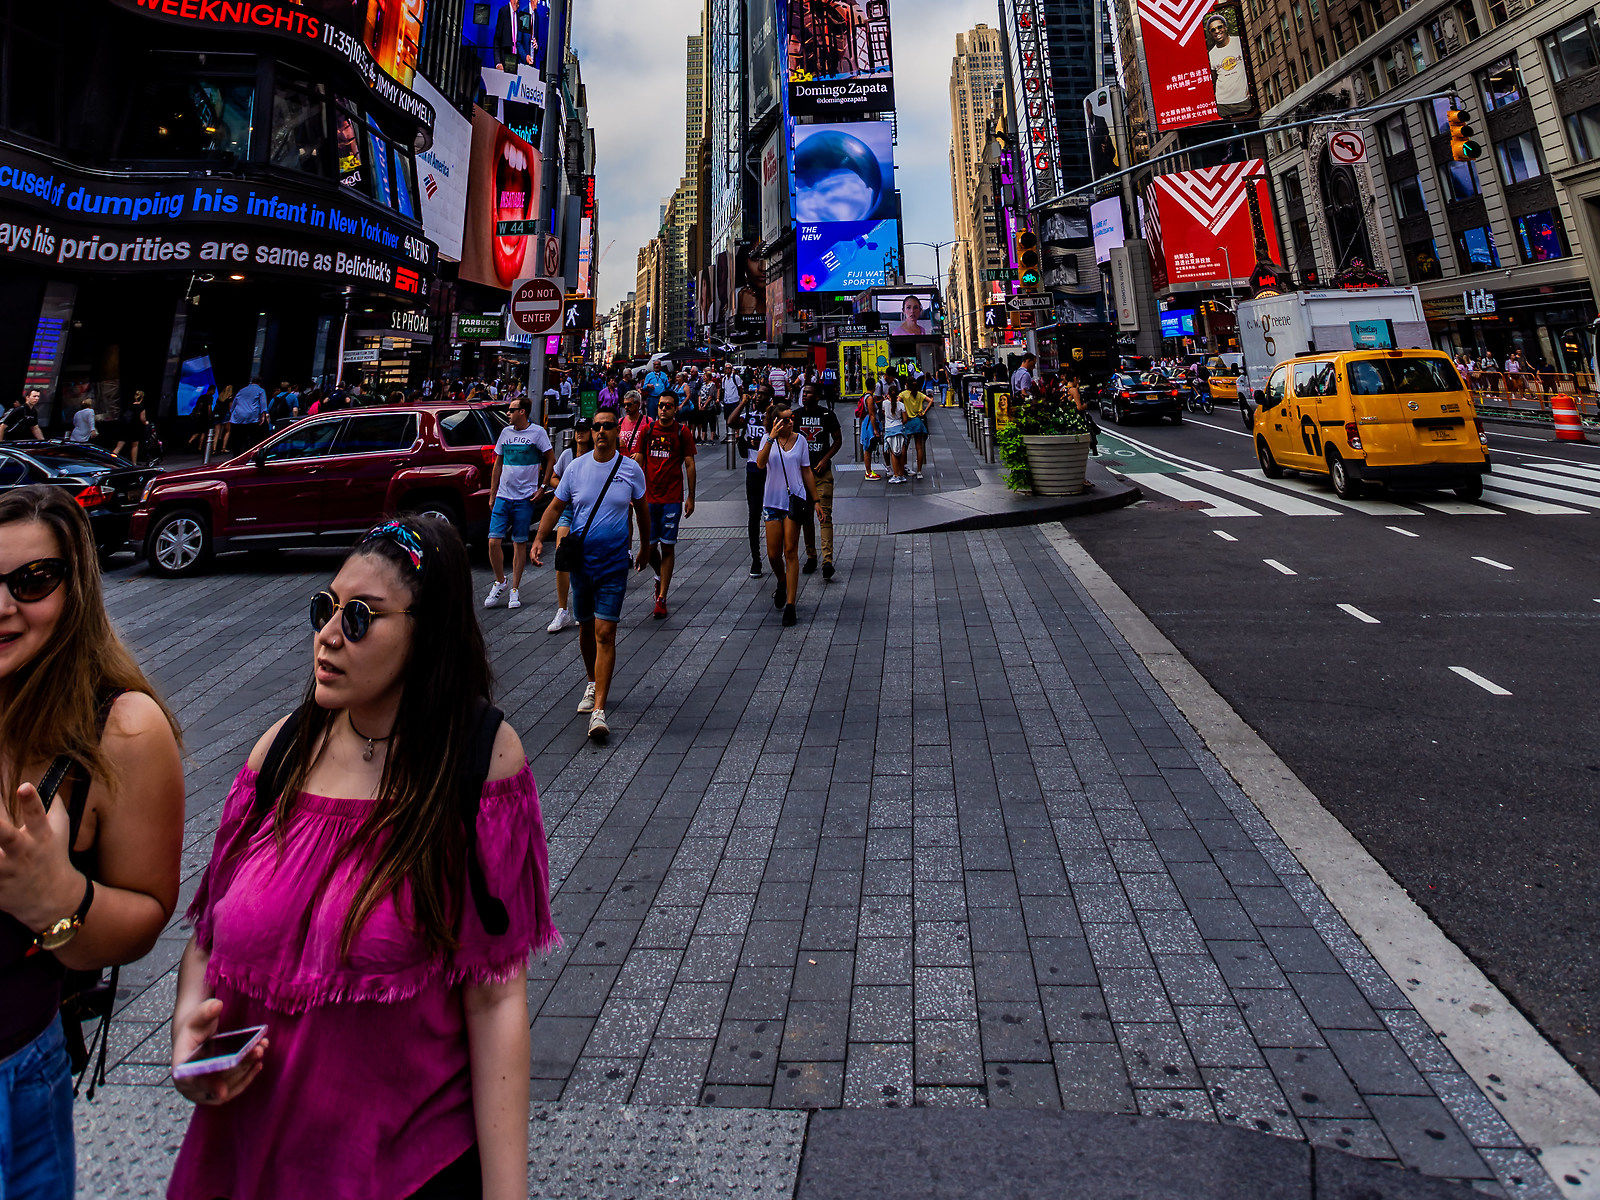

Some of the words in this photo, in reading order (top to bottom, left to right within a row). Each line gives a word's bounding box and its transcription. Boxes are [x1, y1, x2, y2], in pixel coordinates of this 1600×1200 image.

[1020, 12, 1032, 28] &
[376, 73, 399, 104] JIMMY
[521, 83, 544, 103] Nasdaq
[795, 83, 847, 98] Domingo
[848, 82, 888, 97] Zapata
[816, 96, 868, 104] @domingozapata
[1023, 51, 1049, 171] YOUNG
[432, 153, 449, 178] America
[0, 165, 52, 202] cused
[52, 182, 65, 207] of
[67, 186, 184, 221] dumping
[193, 188, 239, 213] his
[247, 191, 307, 223] infant
[311, 204, 325, 227] in
[329, 208, 357, 236] New
[361, 215, 381, 244] York
[382, 226, 400, 250] river
[410, 235, 430, 265] NEWS
[499, 223, 507, 234] W
[510, 222, 524, 233] 44
[0, 221, 31, 250] ays
[32, 226, 55, 255] his
[57, 235, 191, 264] priorities
[200, 238, 249, 262] are
[255, 243, 310, 268] same
[313, 255, 332, 272] as
[336, 252, 391, 284] Belichick's
[395, 266, 419, 295] ESPN
[821, 251, 841, 272] FIJI
[847, 270, 863, 278] FIJI
[866, 269, 886, 277] WAT
[988, 271, 996, 280] W
[999, 270, 1010, 279] 44
[843, 278, 875, 286] SPORTS
[521, 289, 533, 299] DO
[536, 288, 554, 298] NOT
[1032, 297, 1047, 305] WAY
[1463, 288, 1496, 315] Lids
[391, 311, 429, 333] SEPHORA
[522, 313, 551, 323] ENTER
[802, 416, 821, 426] TEAM
